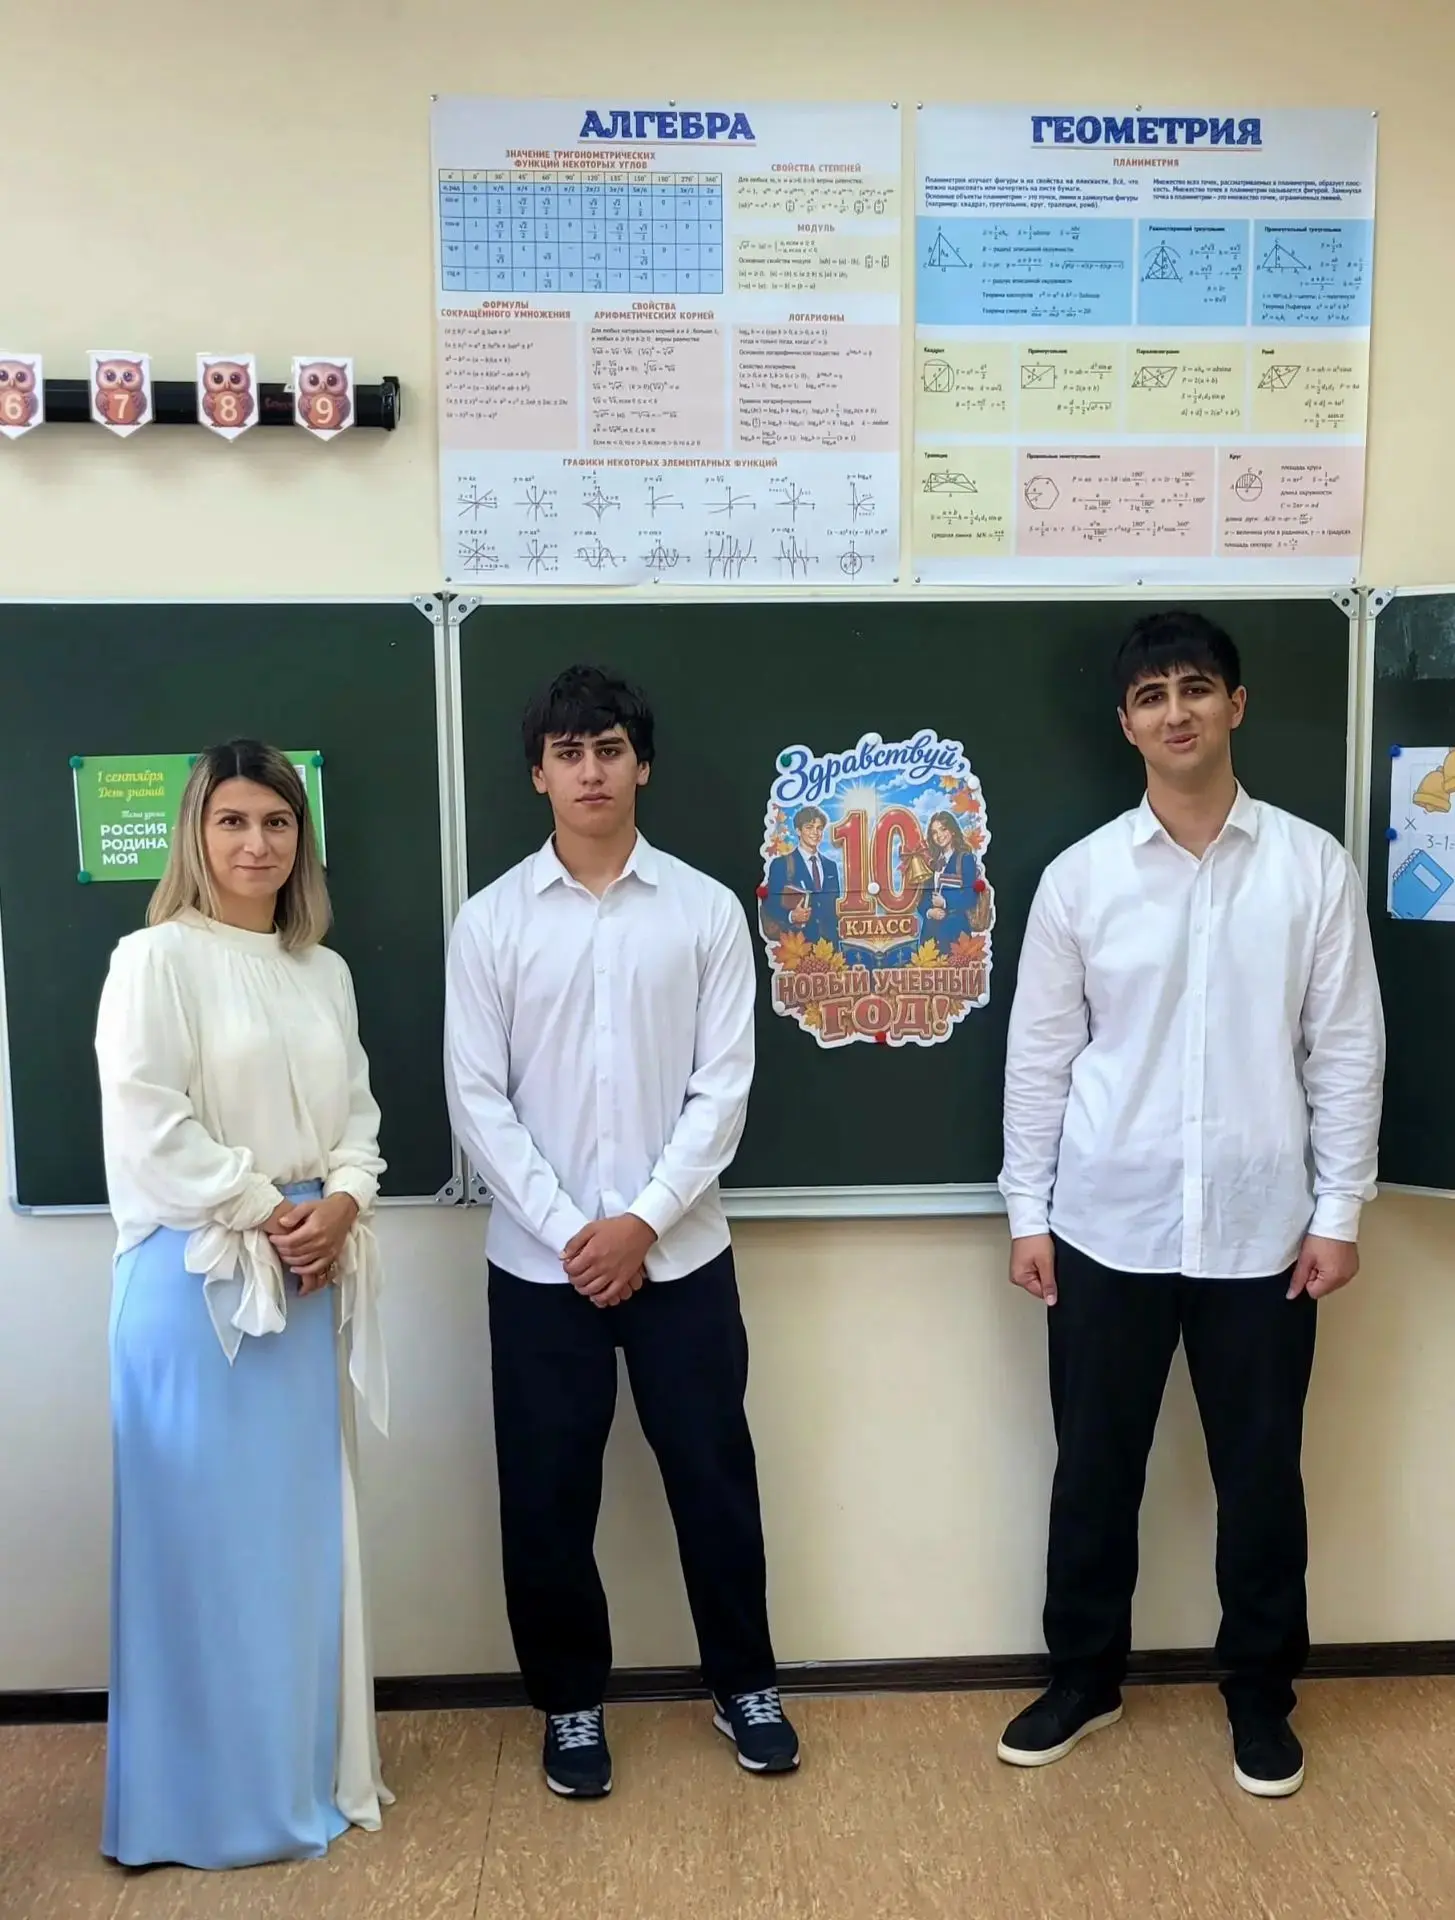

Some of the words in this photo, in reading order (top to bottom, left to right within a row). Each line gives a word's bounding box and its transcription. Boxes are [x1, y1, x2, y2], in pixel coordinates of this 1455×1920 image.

[579, 111, 756, 140] АЛГЕБРА
[1031, 116, 1262, 144] ГЕОМЕТРИЯ
[506, 150, 550, 159] ЗНАЧЕНИЕ
[553, 151, 656, 160] ТРИГОНОМЕТРИЧЕСКИХ
[514, 159, 560, 168] ФУНКЦИЙ
[563, 160, 615, 168] НЕКОТОРЫХ
[618, 161, 648, 169] УГЛОВ
[771, 163, 815, 172] СВОЙСТВА
[818, 163, 862, 173] СТЕПЕНЕЙ
[1113, 158, 1179, 167] ПЛАНИМЕТРИЯ
[798, 224, 836, 233] МОДУЛЬ
[482, 301, 528, 310] ФОРМУЛЫ
[632, 302, 676, 310] СВОЙСТВА
[441, 308, 511, 318] СОКРАЩЁННОГО
[514, 310, 571, 319] УМНОЖЕНИЯ
[594, 312, 676, 320] АРИФМЕТИЧЕСКИХ
[680, 311, 714, 320] КОРНЕЙ
[788, 314, 844, 322] ЛОГАРИФМЫ
[6, 394, 23, 420] 6
[114, 394, 130, 419] 7
[220, 394, 238, 421] 8
[316, 398, 332, 424] 9
[734, 457, 778, 466] ФУНКЦИЙ
[776, 735, 965, 801] Здравствуй,
[106, 770, 164, 786] сентября
[98, 787, 124, 798] День
[126, 786, 164, 802] знаний
[100, 823, 167, 836] РОССИЯ
[102, 838, 168, 852] РОДИНА
[102, 853, 138, 865] МОЯ
[833, 809, 930, 917] 10
[845, 919, 912, 936] КЛАСС
[778, 966, 869, 999] НОВЫЙ
[873, 962, 986, 996] УЧЕБНЫЙ
[819, 994, 951, 1042] ГОД!
